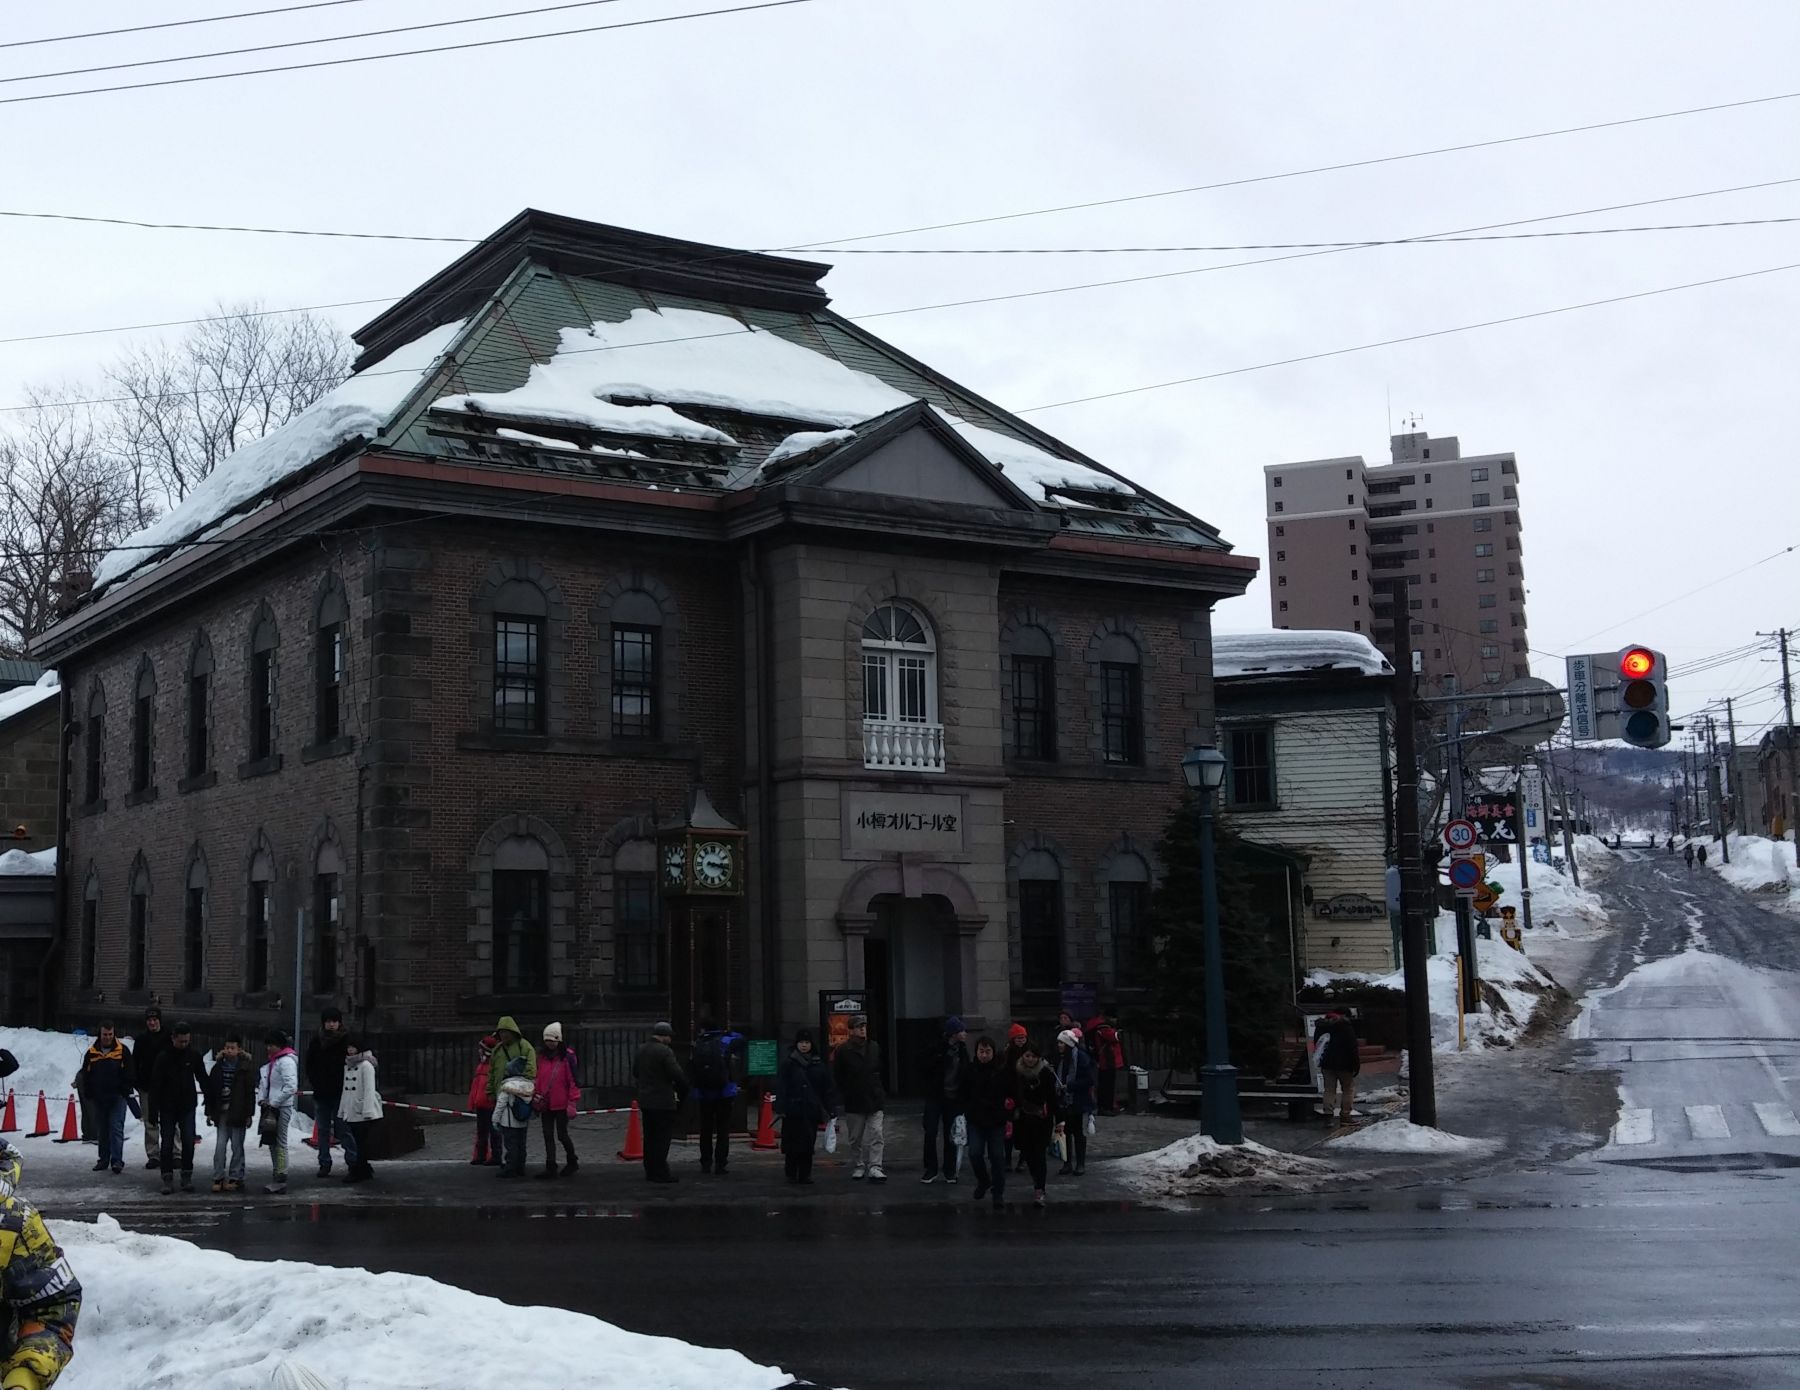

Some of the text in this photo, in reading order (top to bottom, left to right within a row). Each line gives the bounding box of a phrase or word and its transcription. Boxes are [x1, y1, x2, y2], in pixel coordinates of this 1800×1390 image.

[1573, 659, 1590, 737] 歩車分離式信号
[856, 810, 957, 832] 小樽オルゴール堂
[1452, 828, 1469, 842] 30
